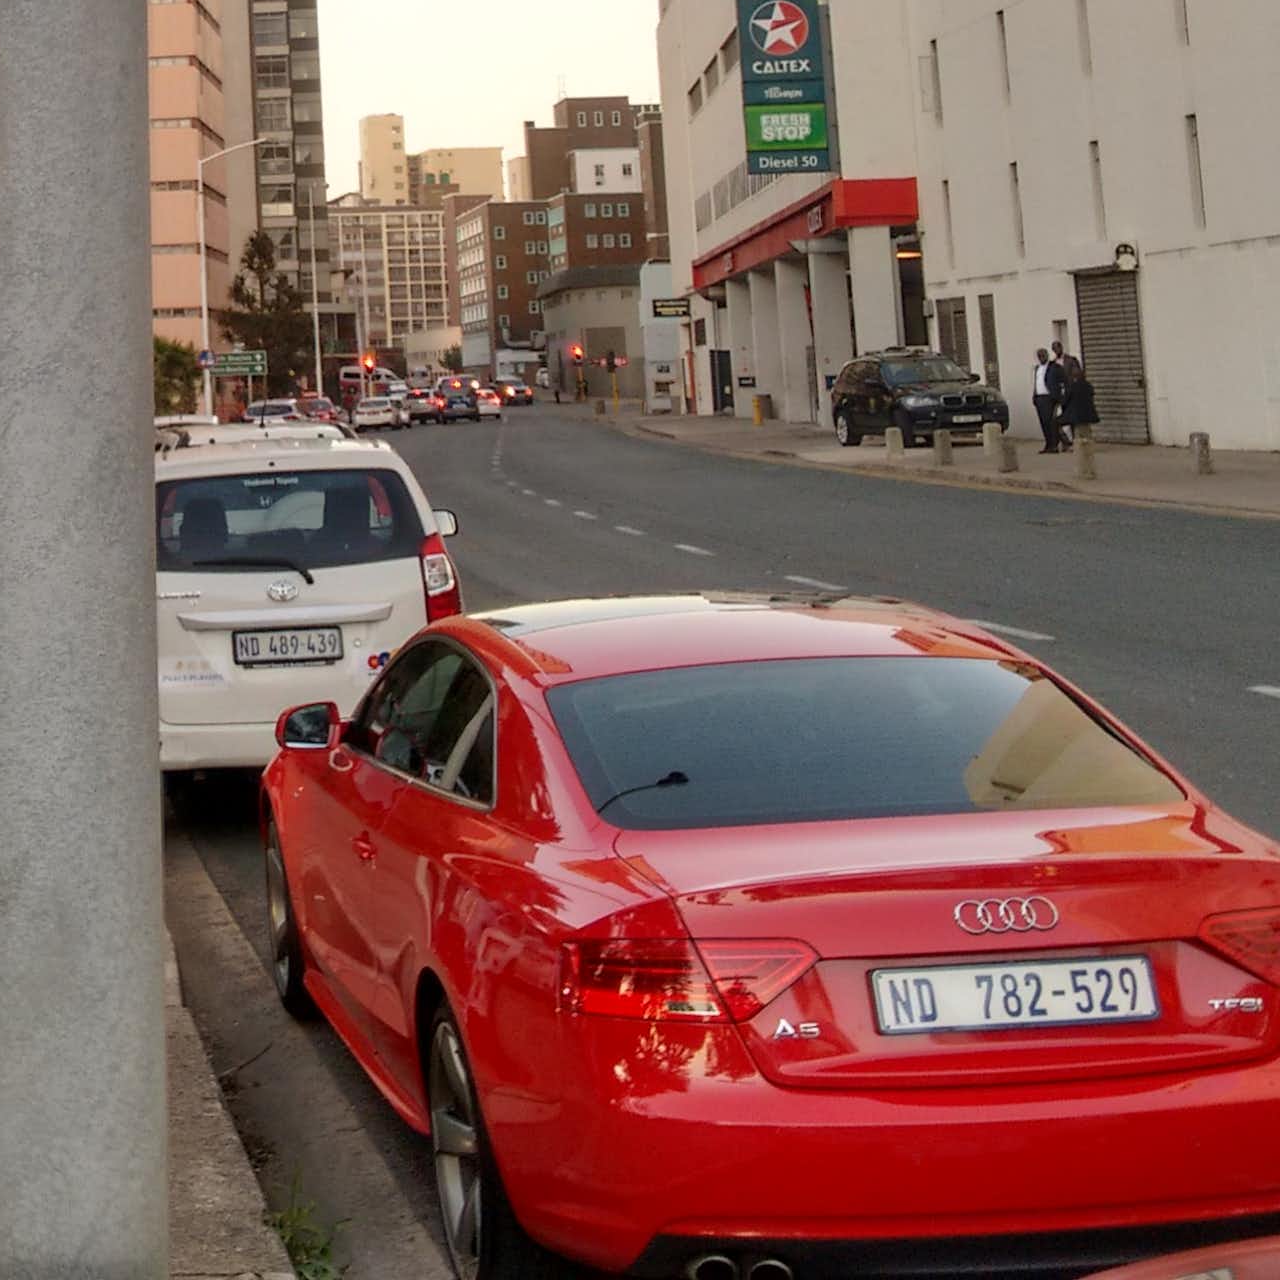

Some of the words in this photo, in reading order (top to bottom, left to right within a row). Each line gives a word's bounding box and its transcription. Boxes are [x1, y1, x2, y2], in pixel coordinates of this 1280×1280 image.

[752, 60, 811, 74] CALTEX
[761, 113, 811, 127] FRESH
[761, 126, 812, 141] STOP
[759, 156, 798, 168] Diesel
[802, 155, 818, 167] 50
[239, 637, 260, 656] ND
[269, 633, 337, 656] 489-439
[888, 978, 938, 1025] ND
[975, 967, 1138, 1020] 782-529
[1207, 997, 1263, 1012] TFSI
[773, 1018, 820, 1038] A5
